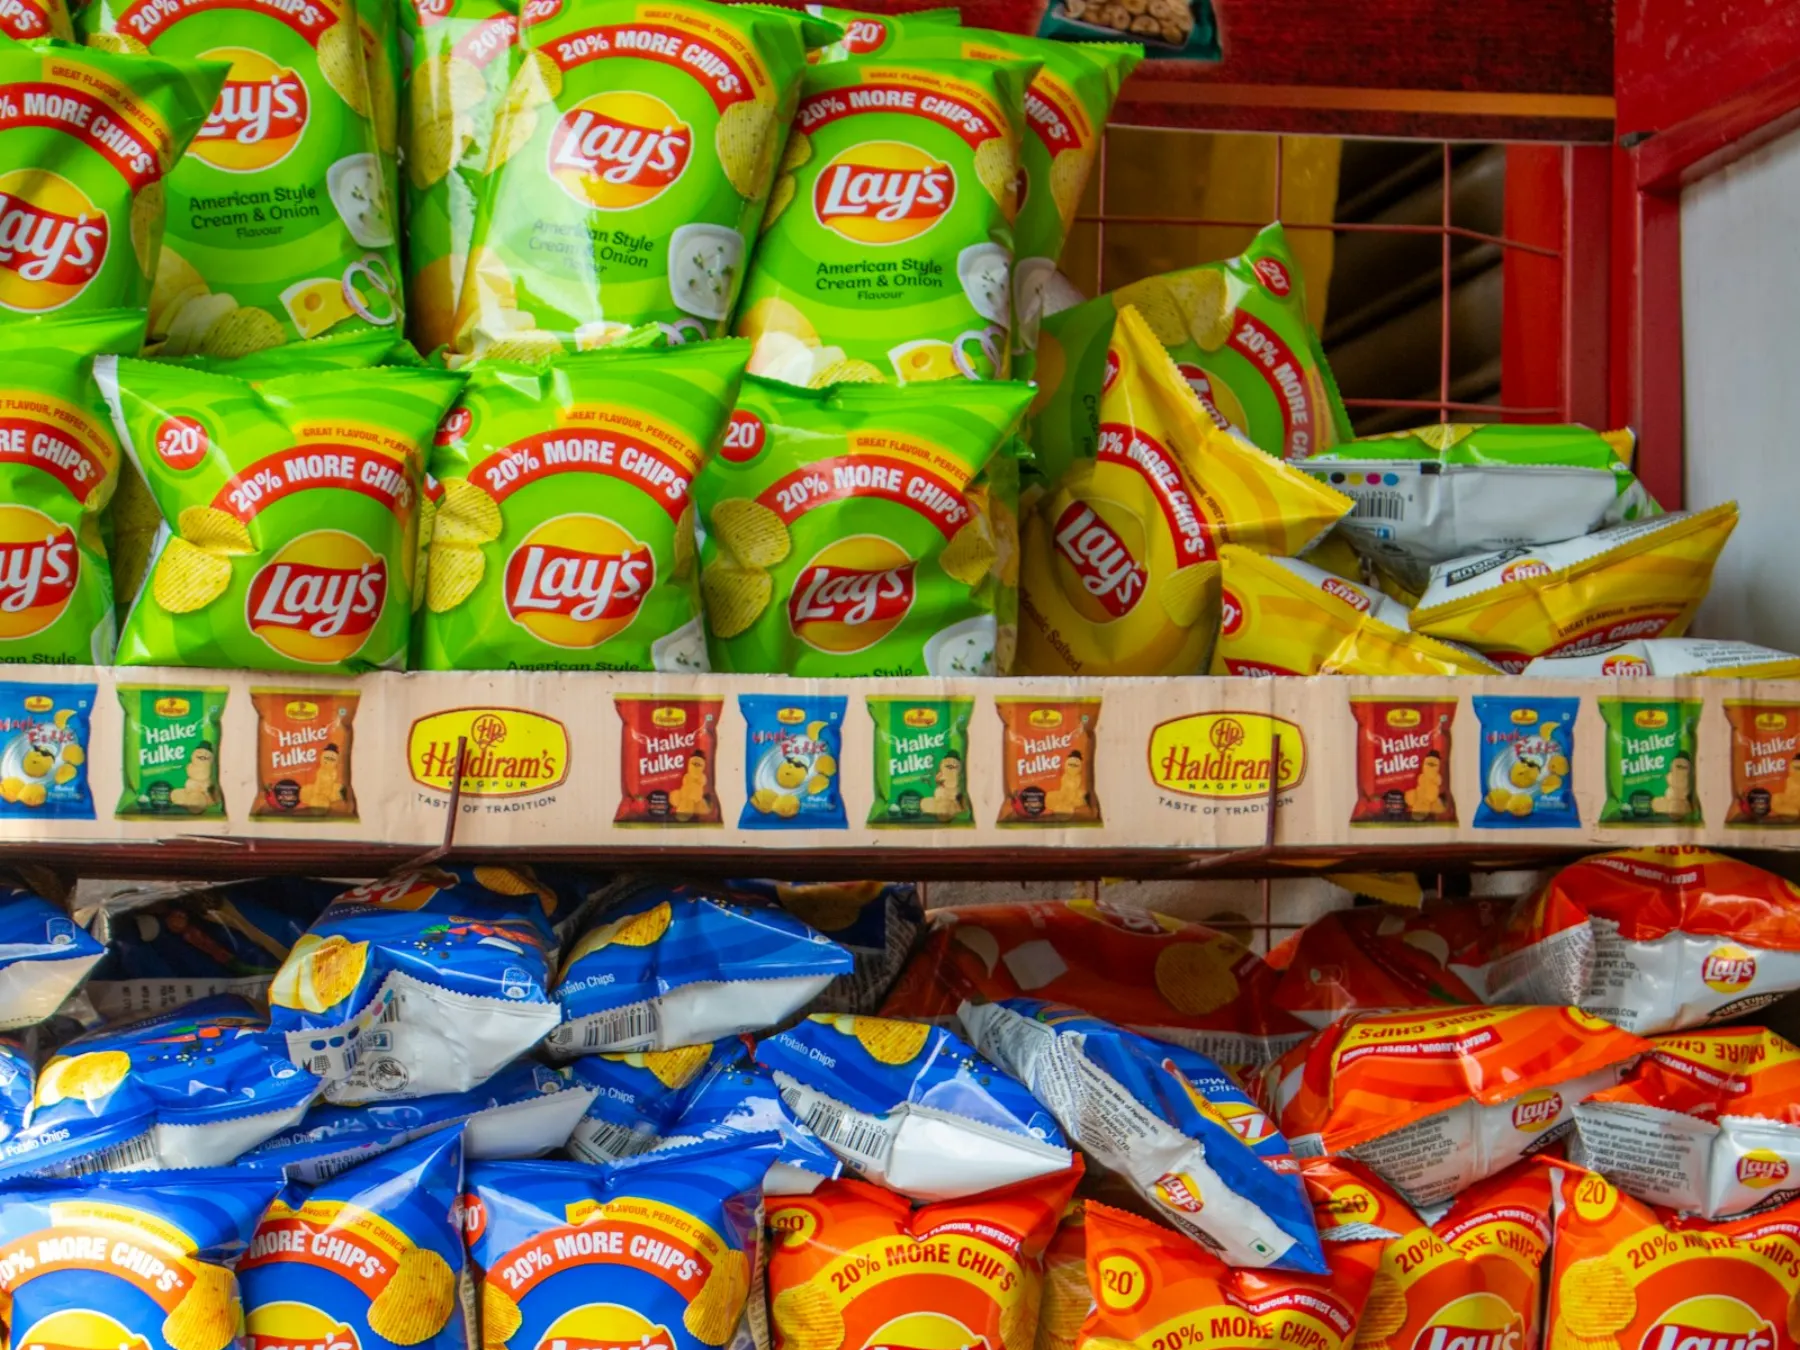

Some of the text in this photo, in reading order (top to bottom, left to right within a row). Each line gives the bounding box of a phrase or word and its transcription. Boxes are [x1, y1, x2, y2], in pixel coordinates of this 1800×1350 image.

[558, 31, 678, 62] 20% MORE
[24, 92, 92, 128] MORE
[850, 90, 916, 108] MORE
[555, 112, 684, 185] Lay's
[189, 185, 316, 212] American Style
[822, 165, 948, 223] Lay's
[191, 203, 320, 231] Cream & Onion
[815, 272, 944, 290] Cream & Onion
[816, 257, 943, 279] American Style
[856, 290, 905, 301] Flavour
[485, 449, 541, 491] 20%
[542, 439, 615, 465] MORE
[776, 473, 829, 514] 20%
[1055, 504, 1144, 605] Lay's
[513, 547, 648, 622] Lay's
[254, 562, 378, 639] Lay's
[145, 723, 197, 745] Halke
[278, 726, 327, 748] Halke
[647, 733, 696, 753] Halke
[1024, 733, 1072, 754] Halke
[1627, 733, 1676, 755] Halke
[139, 745, 185, 766] Fulke
[271, 747, 317, 768] Fulke
[421, 742, 556, 779] Haldiram's
[639, 754, 685, 775] Fulke
[1017, 755, 1061, 776] Fulke
[1620, 754, 1665, 776] Fulke
[487, 795, 557, 814] TRADITION
[1203, 805, 1219, 815] OF
[555, 972, 616, 999] Potato Chips
[779, 1034, 837, 1069] Potato Chips
[1512, 1097, 1562, 1126] Lay's
[41, 1128, 70, 1148] Chips
[1738, 1154, 1789, 1183] Lay's
[502, 1231, 624, 1290] 20% MORE
[830, 1244, 951, 1293] 20% MORE
